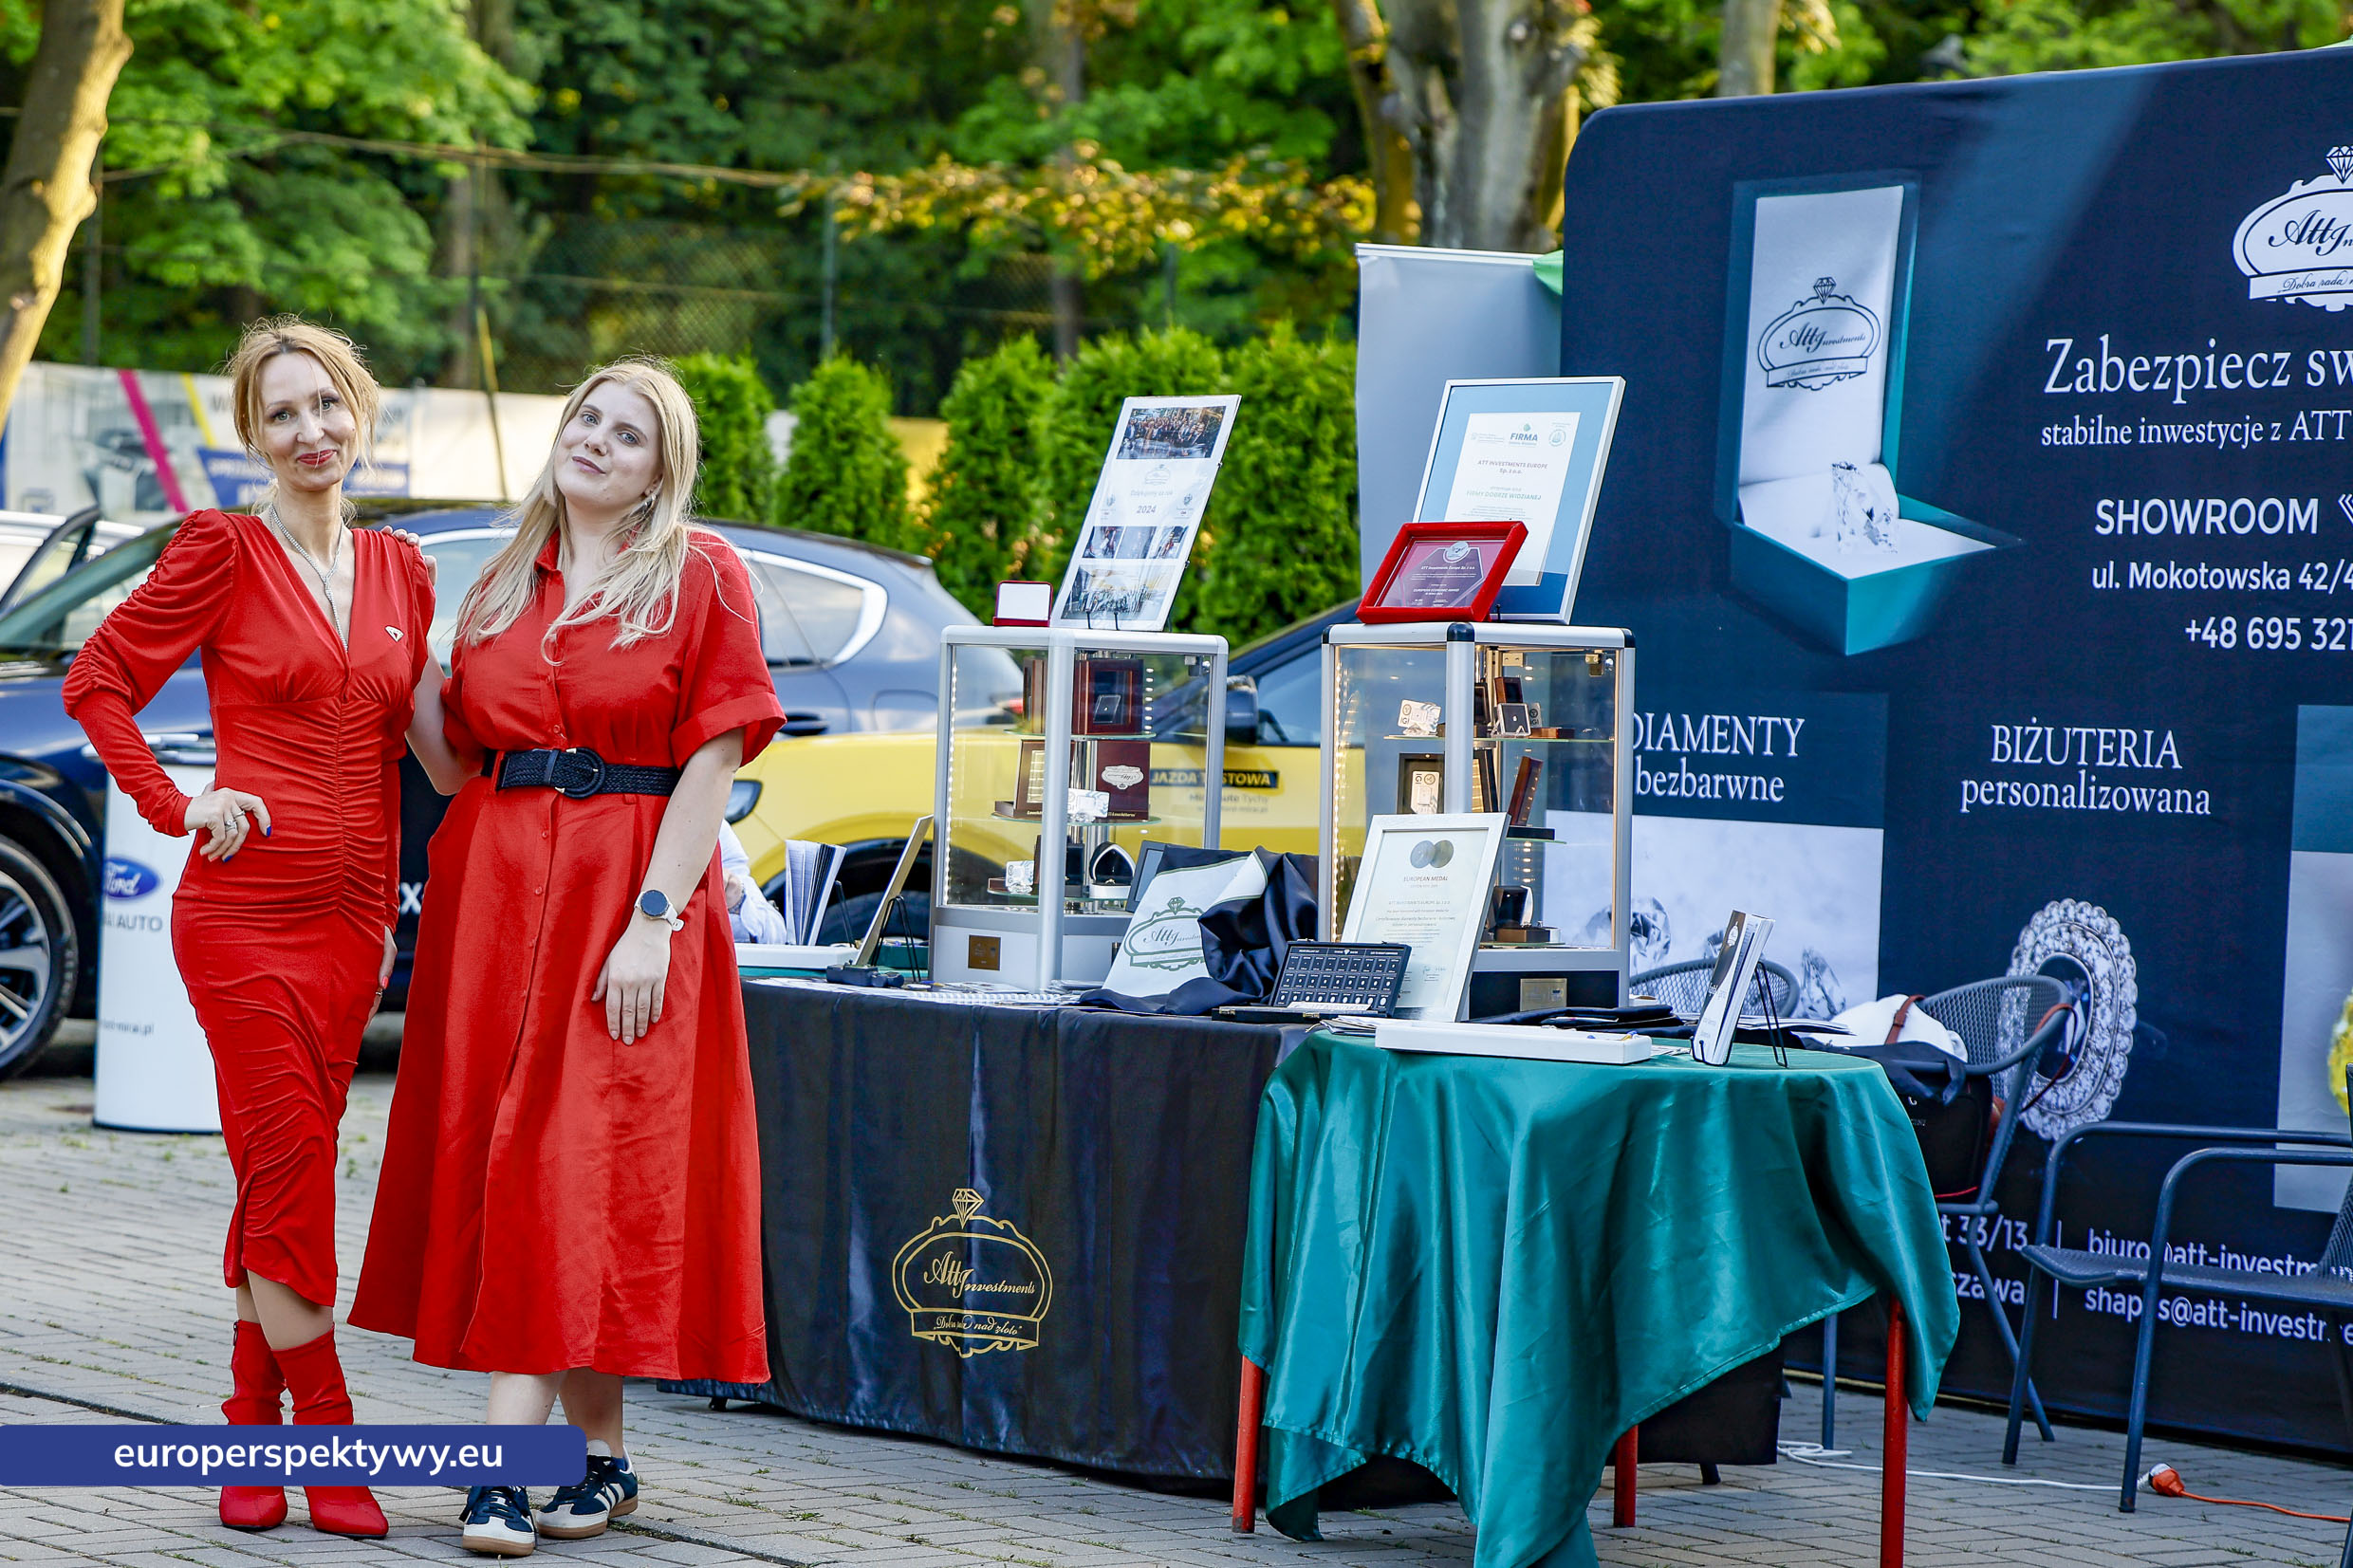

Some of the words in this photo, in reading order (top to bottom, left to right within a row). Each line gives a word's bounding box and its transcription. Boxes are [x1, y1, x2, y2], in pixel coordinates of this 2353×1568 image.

[2044, 334, 2291, 404] Zabezpiecz
[1510, 433, 1539, 442] FIRMA
[2041, 414, 2133, 446] stabilne
[2138, 415, 2264, 450] inwestycje
[2270, 422, 2282, 441] z
[2288, 410, 2352, 441] ATT
[1136, 505, 1158, 514] 2024
[2094, 497, 2319, 535] SHOWROOM
[2092, 561, 2121, 589] ul.
[2128, 561, 2291, 590] Mokotowska
[2185, 616, 2237, 649] +48
[2246, 617, 2302, 651] 695
[1991, 716, 2182, 769] BIŻUTERIA
[1151, 771, 1197, 784] JAZDA
[1200, 772, 1271, 786] TSTOWA
[1635, 754, 1785, 802] bezbarwne
[1959, 769, 2212, 815] personalizowana
[104, 860, 142, 896] Ford
[117, 913, 163, 932] AUTO
